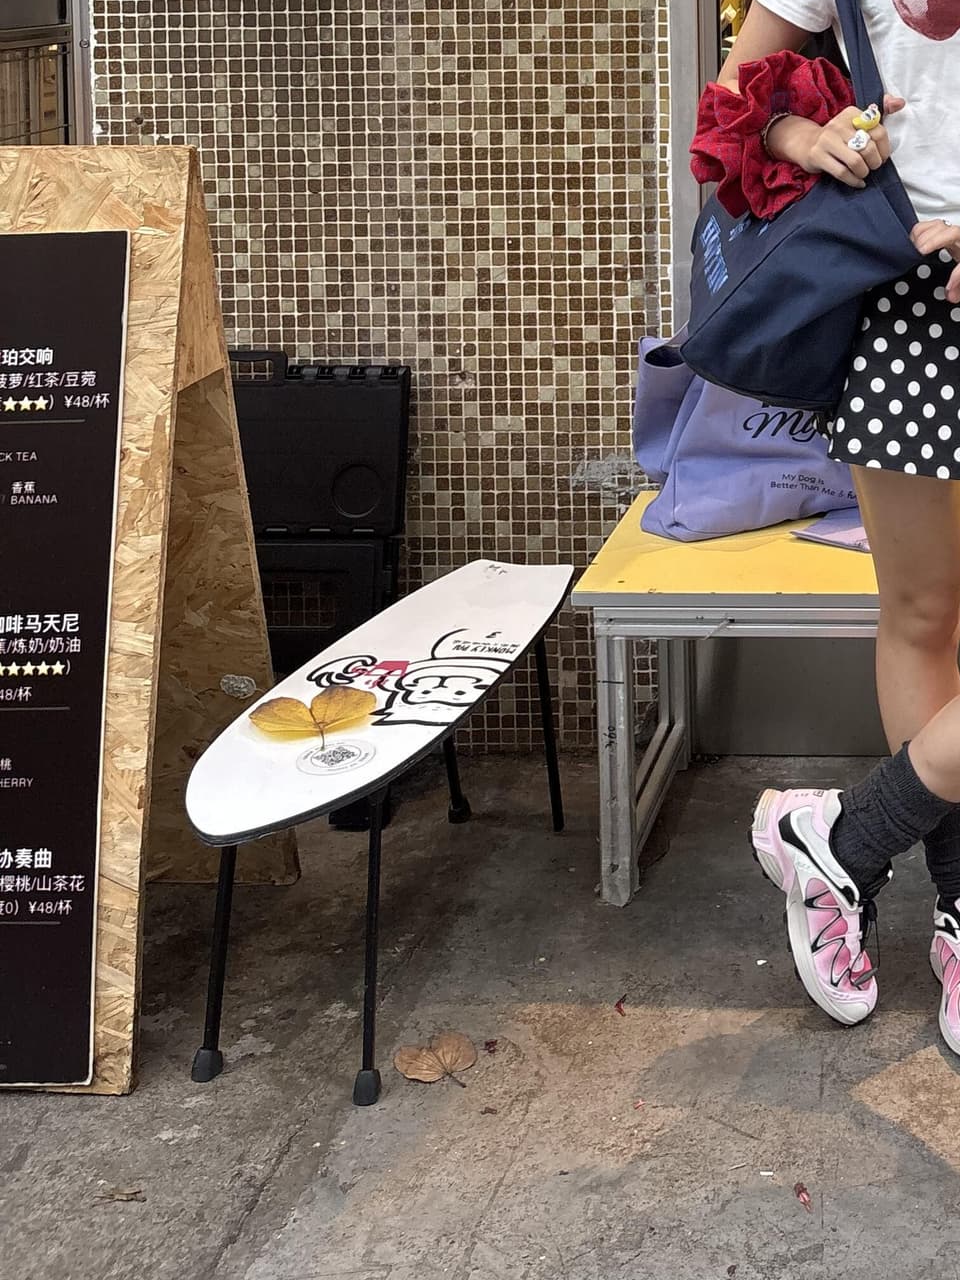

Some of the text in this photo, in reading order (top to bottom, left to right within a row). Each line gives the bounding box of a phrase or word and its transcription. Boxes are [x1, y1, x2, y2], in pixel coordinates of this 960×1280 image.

[0, 347, 54, 366] 珀交响
[16, 451, 37, 461] TEA
[770, 481, 798, 489] Better
[10, 494, 58, 505] BANANA
